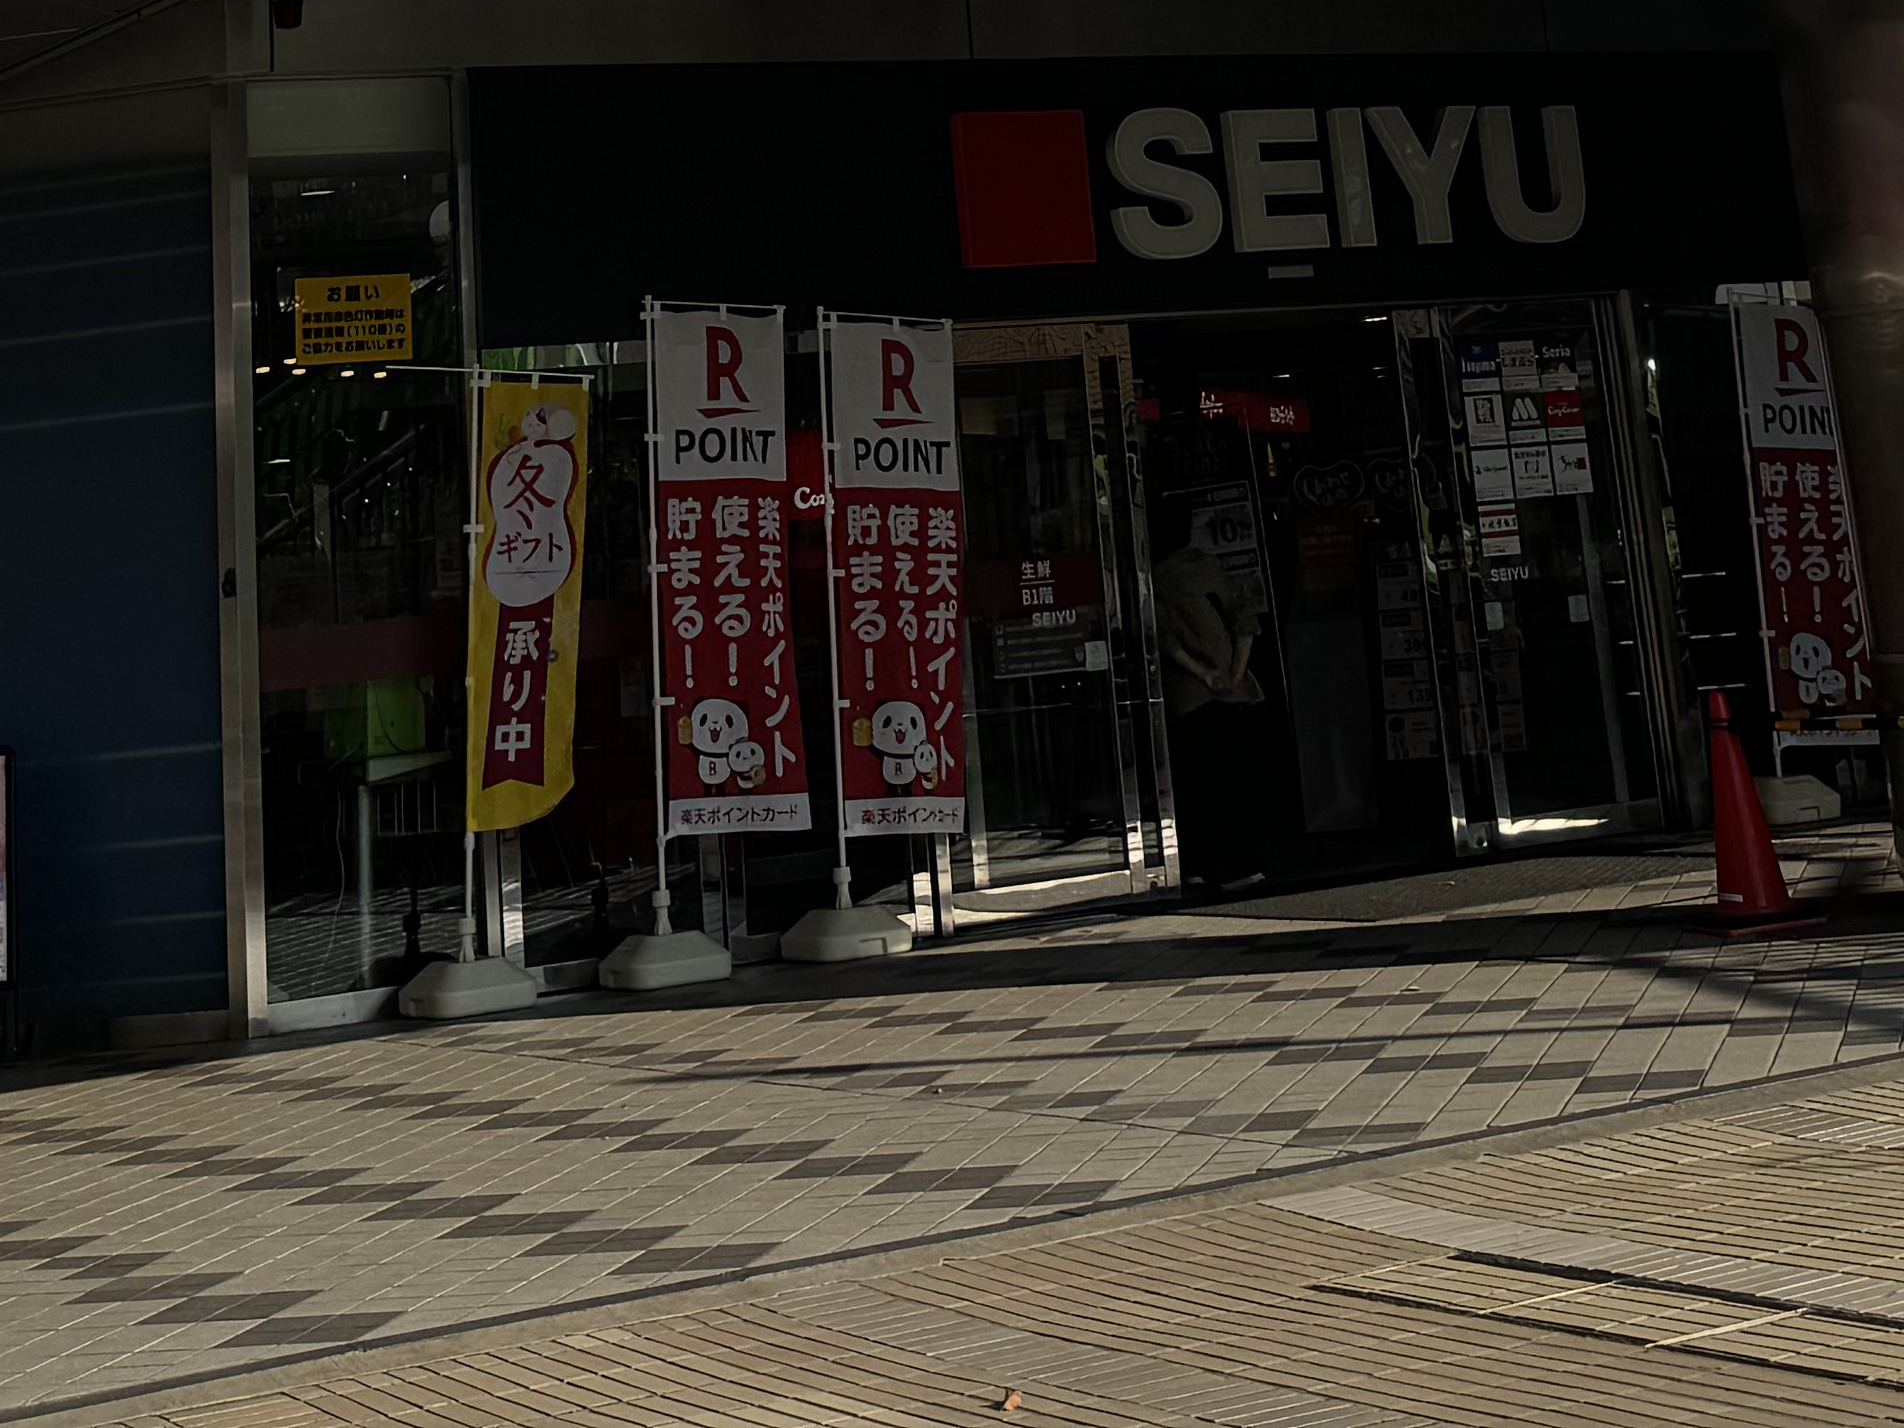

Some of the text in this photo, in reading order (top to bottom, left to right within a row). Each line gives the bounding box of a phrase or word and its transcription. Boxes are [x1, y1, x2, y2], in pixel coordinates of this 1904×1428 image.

[1105, 104, 1587, 262] SEIYU
[326, 284, 380, 303] お願い
[705, 325, 751, 403] R
[880, 338, 923, 415] R
[1541, 344, 1571, 358] Seria
[1774, 318, 1818, 384] R
[674, 426, 777, 465] POINT
[852, 437, 951, 475] POINT
[503, 454, 556, 531] 冬
[497, 531, 563, 564] ギフト
[1021, 559, 1052, 579] 生鮮
[1490, 566, 1529, 582] SEIYU
[756, 496, 797, 780] 楽天ポイント
[924, 506, 958, 781] 楽天ポイント
[1032, 608, 1077, 628] SEIYU
[494, 619, 540, 763] 承り中
